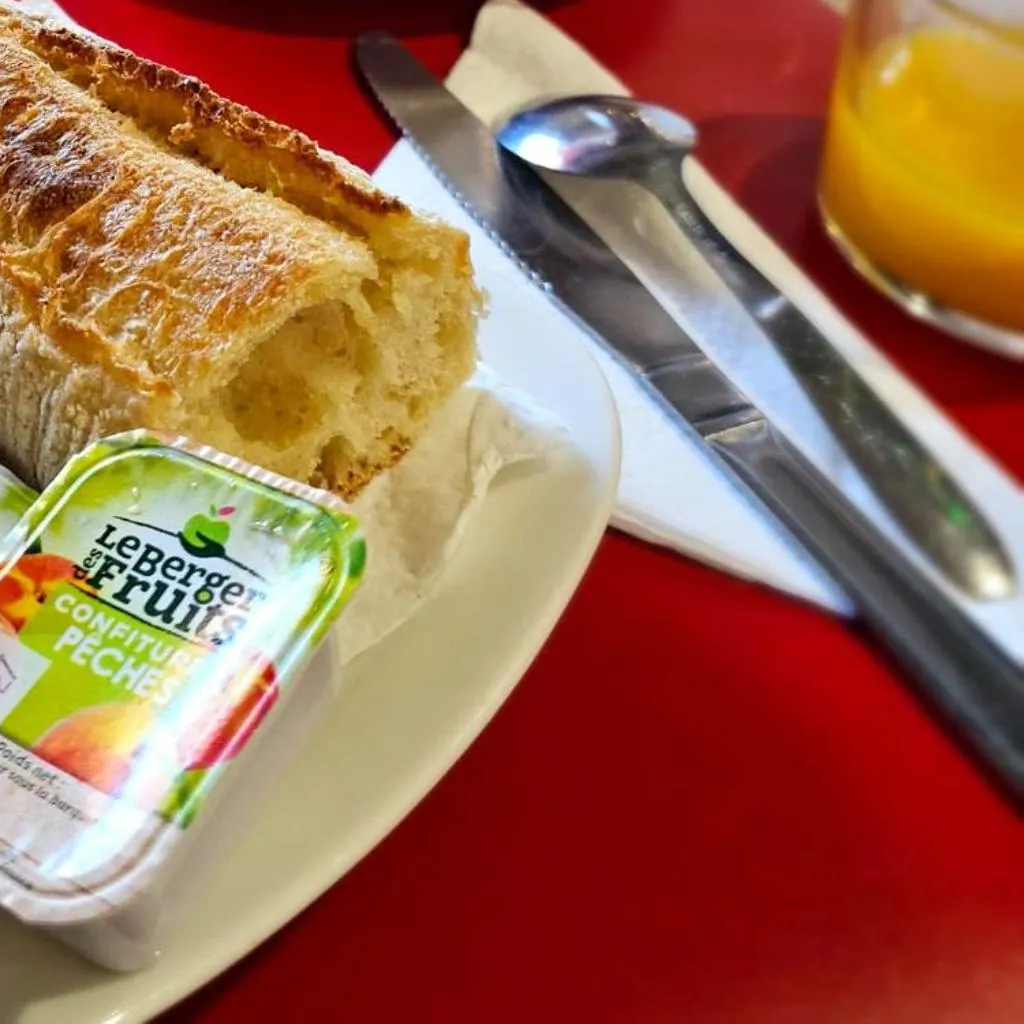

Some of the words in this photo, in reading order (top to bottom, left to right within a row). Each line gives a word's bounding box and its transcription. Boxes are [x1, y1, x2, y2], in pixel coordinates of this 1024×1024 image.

[72, 547, 104, 581] des
[85, 553, 247, 646] Fruits
[54, 593, 196, 668] CONFITUR
